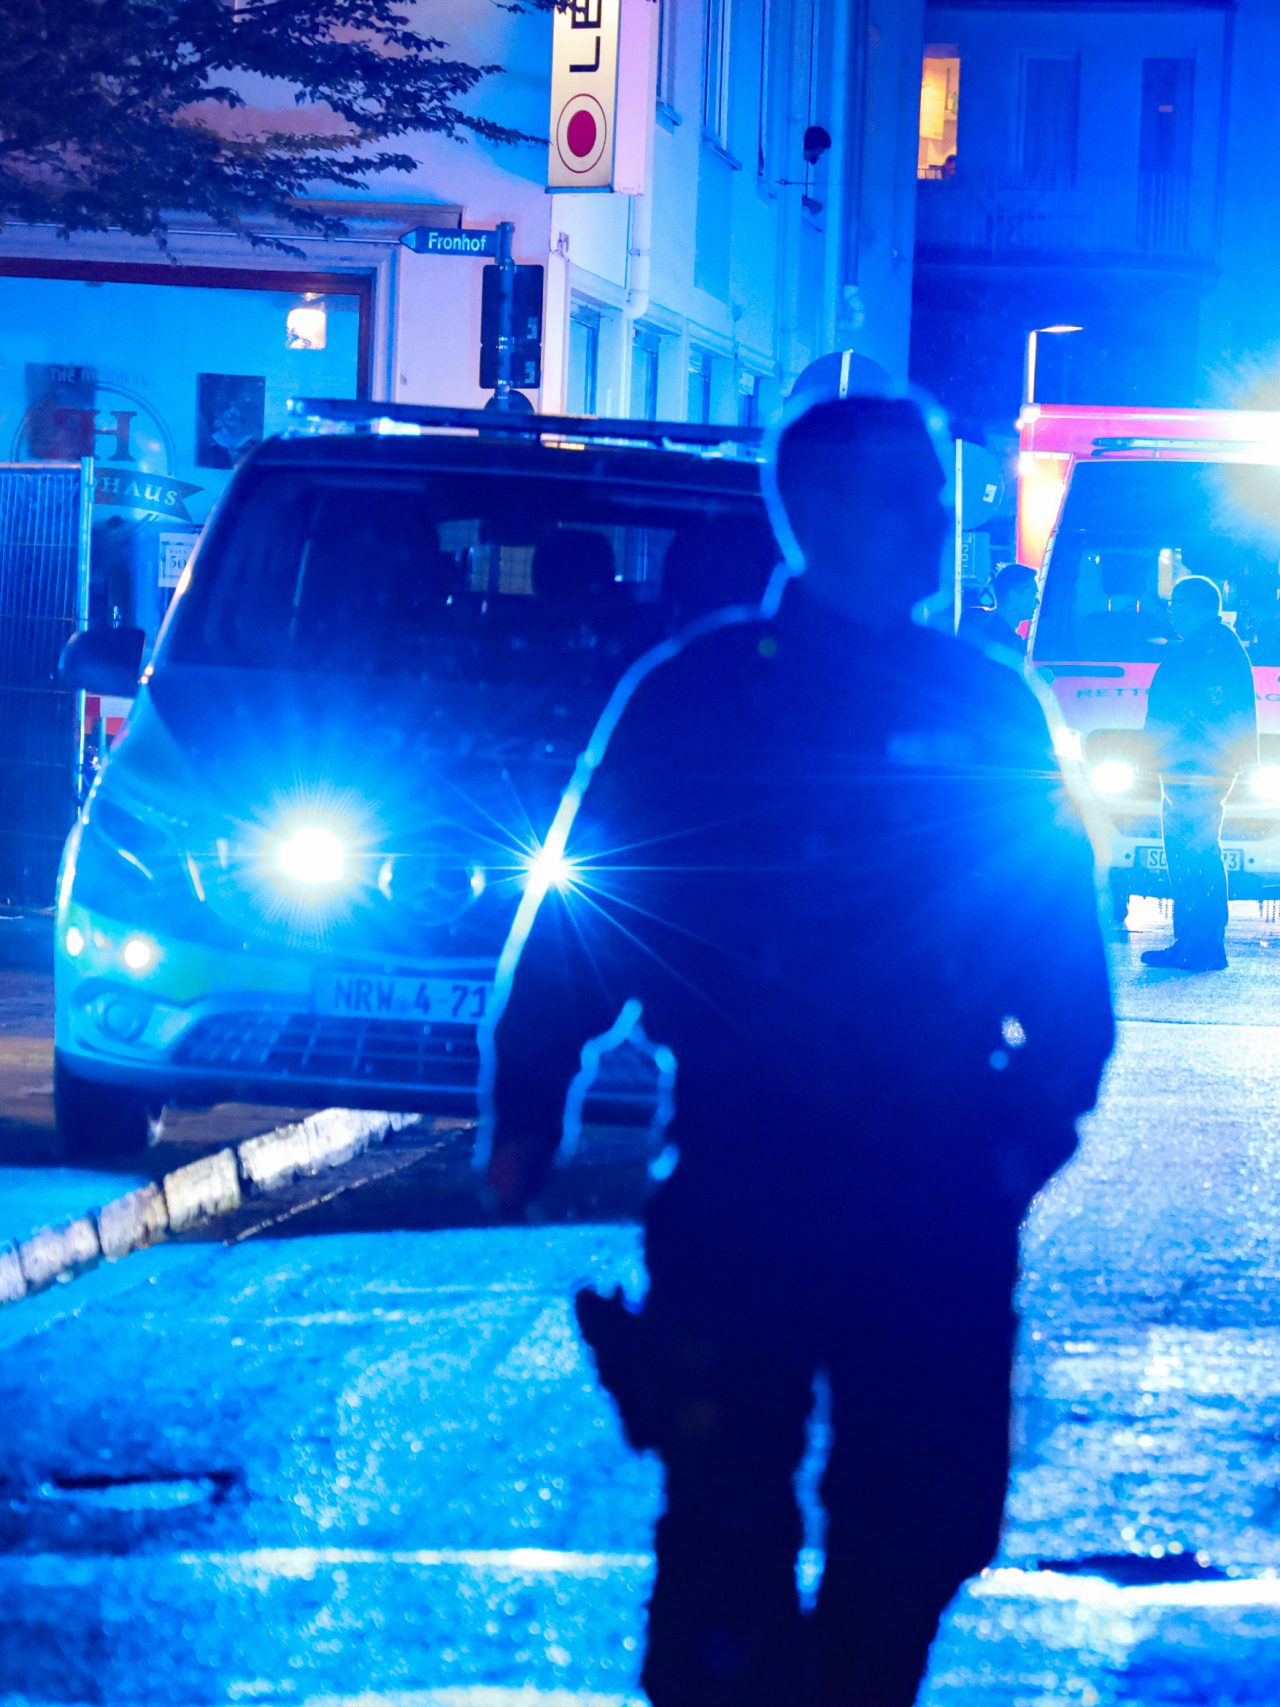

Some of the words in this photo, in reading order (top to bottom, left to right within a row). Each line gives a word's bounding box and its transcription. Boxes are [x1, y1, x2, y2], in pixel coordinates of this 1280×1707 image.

[428, 232, 487, 251] Fronhof
[94, 476, 178, 506] HAUS
[334, 978, 395, 1013] NRW
